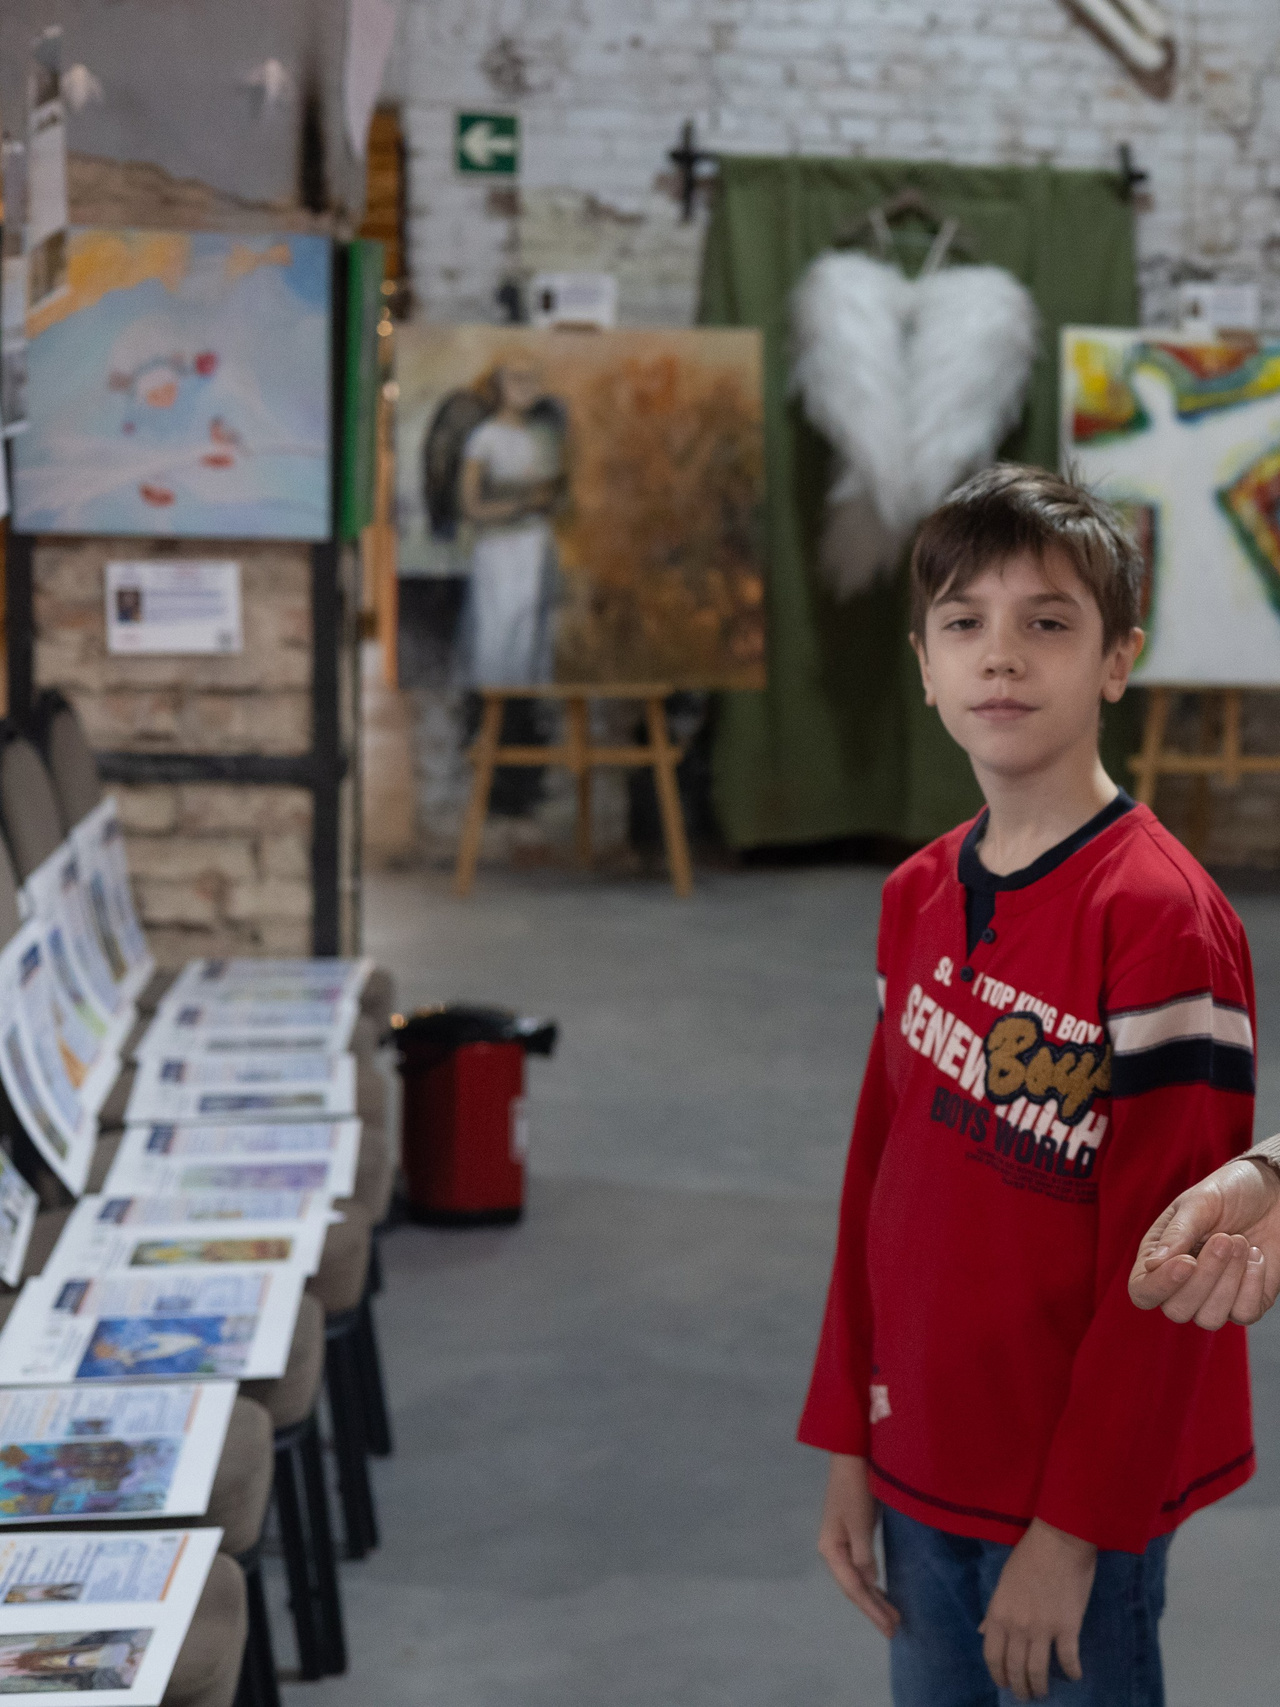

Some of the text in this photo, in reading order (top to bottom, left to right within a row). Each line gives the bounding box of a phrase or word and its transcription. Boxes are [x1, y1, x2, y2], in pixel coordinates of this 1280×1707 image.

[1012, 990, 1058, 1034] KING
[1056, 1012, 1102, 1045] BOY
[931, 1086, 990, 1142] BOYS
[994, 1115, 1096, 1179] WORLD
